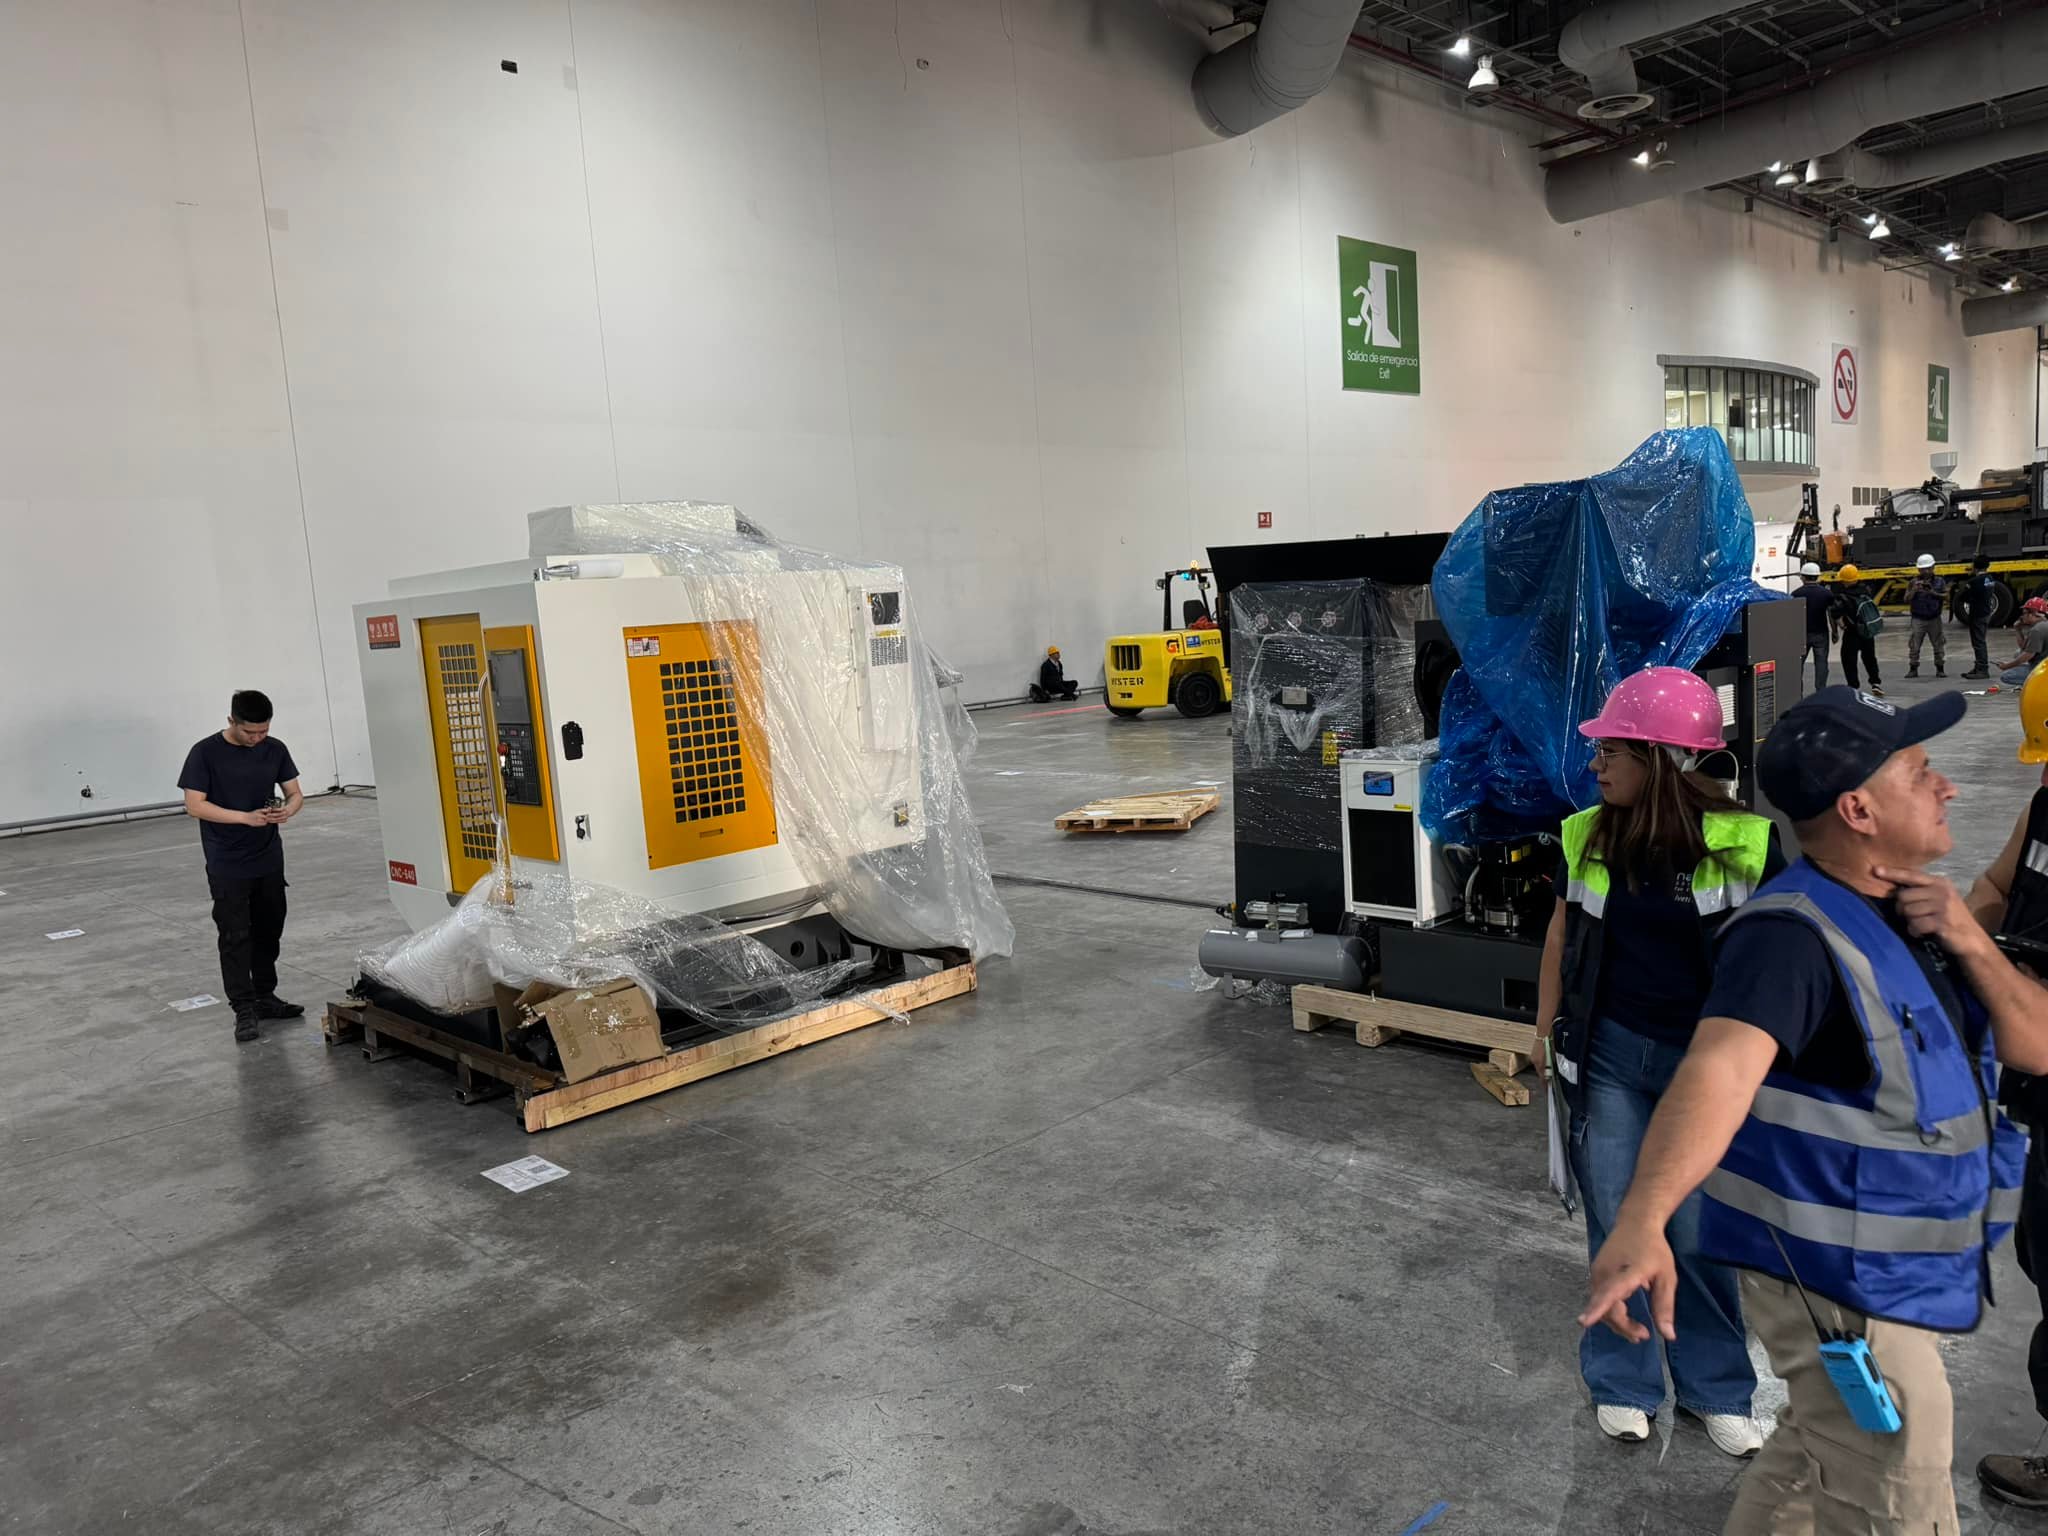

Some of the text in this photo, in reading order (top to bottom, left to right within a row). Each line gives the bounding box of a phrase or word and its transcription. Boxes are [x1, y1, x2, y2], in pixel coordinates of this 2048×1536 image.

[1347, 349, 1418, 368] Salida de emergencia
[1379, 367, 1390, 379] Exit
